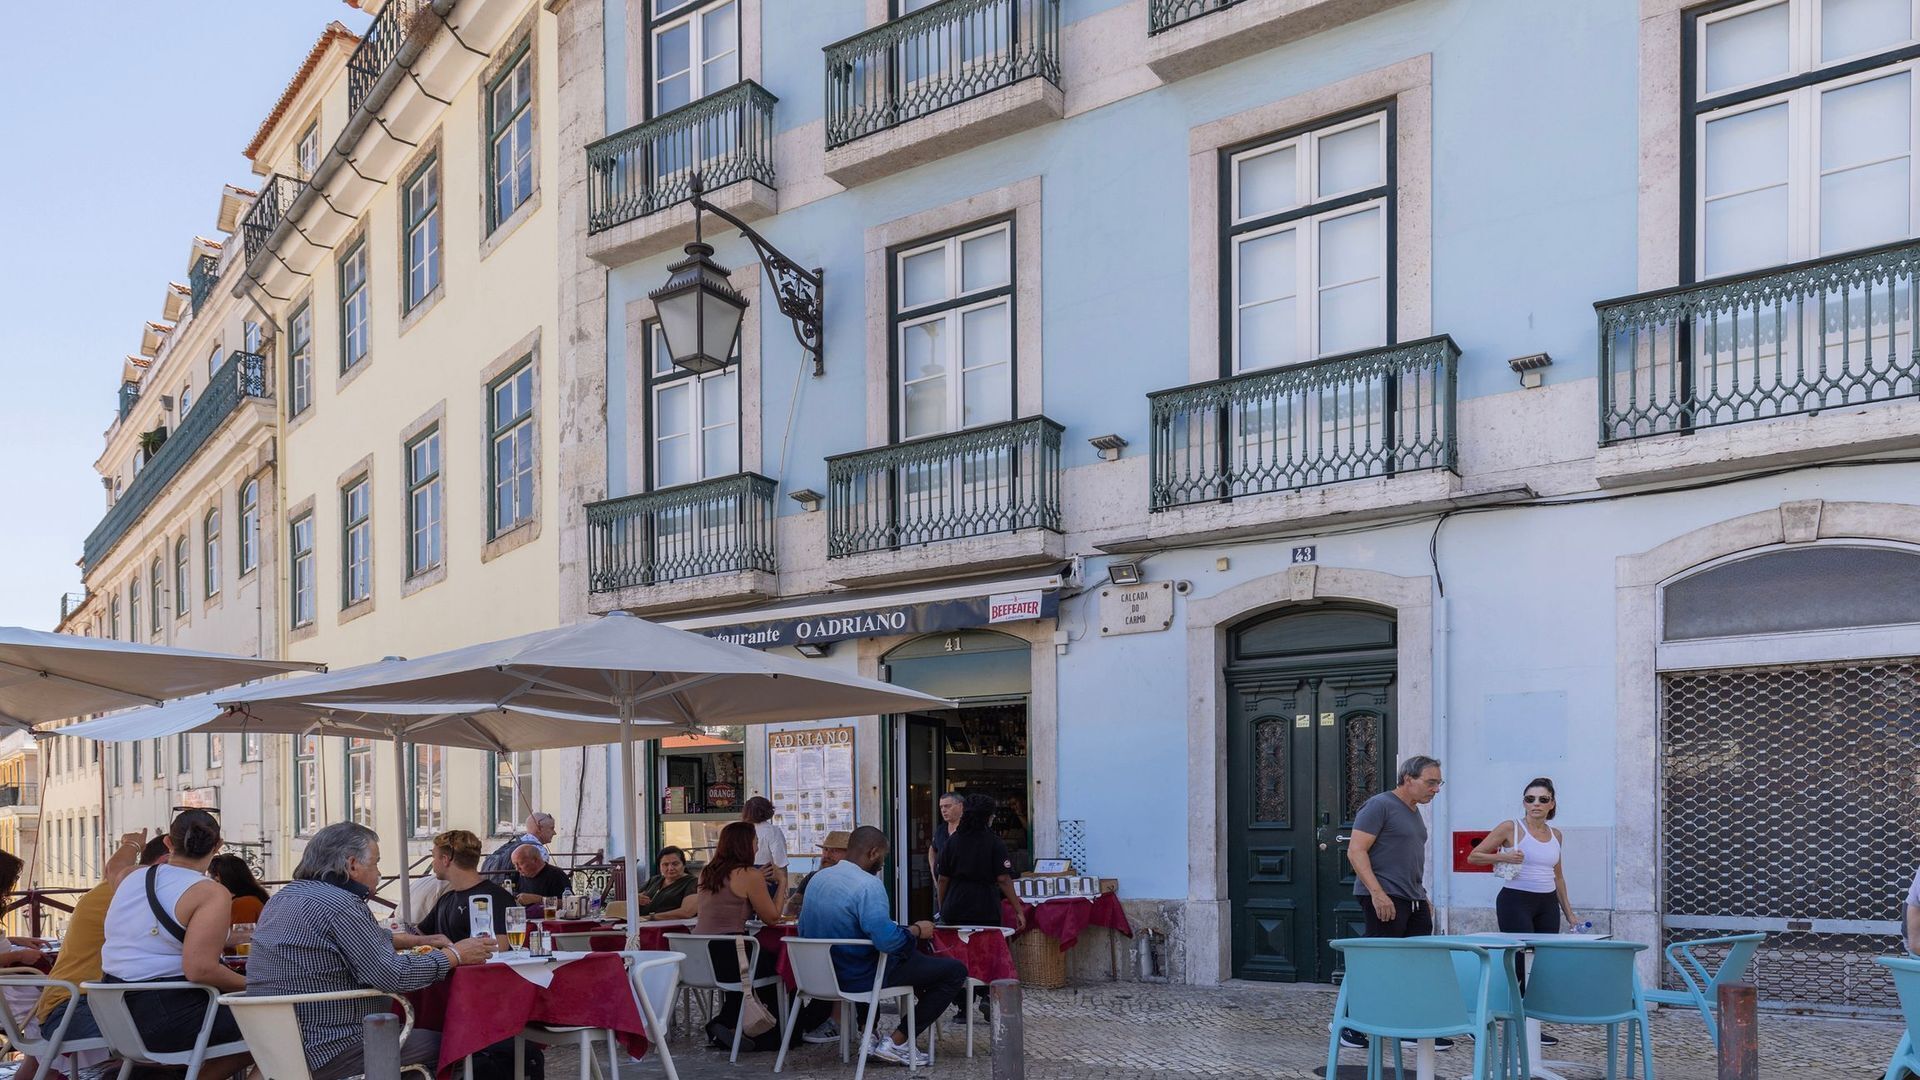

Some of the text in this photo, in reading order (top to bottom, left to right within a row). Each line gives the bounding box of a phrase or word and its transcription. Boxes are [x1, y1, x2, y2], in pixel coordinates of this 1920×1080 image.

[1295, 547, 1312, 562] 43
[991, 601, 1039, 620] BEEFEATER
[1131, 604, 1140, 613] DO
[796, 622, 812, 639] O
[814, 611, 906, 638] ADRIANO
[1125, 614, 1146, 625] CARMO
[944, 637, 962, 652] 41
[774, 730, 850, 748] ADRIANO
[709, 789, 736, 798] ORANGE
